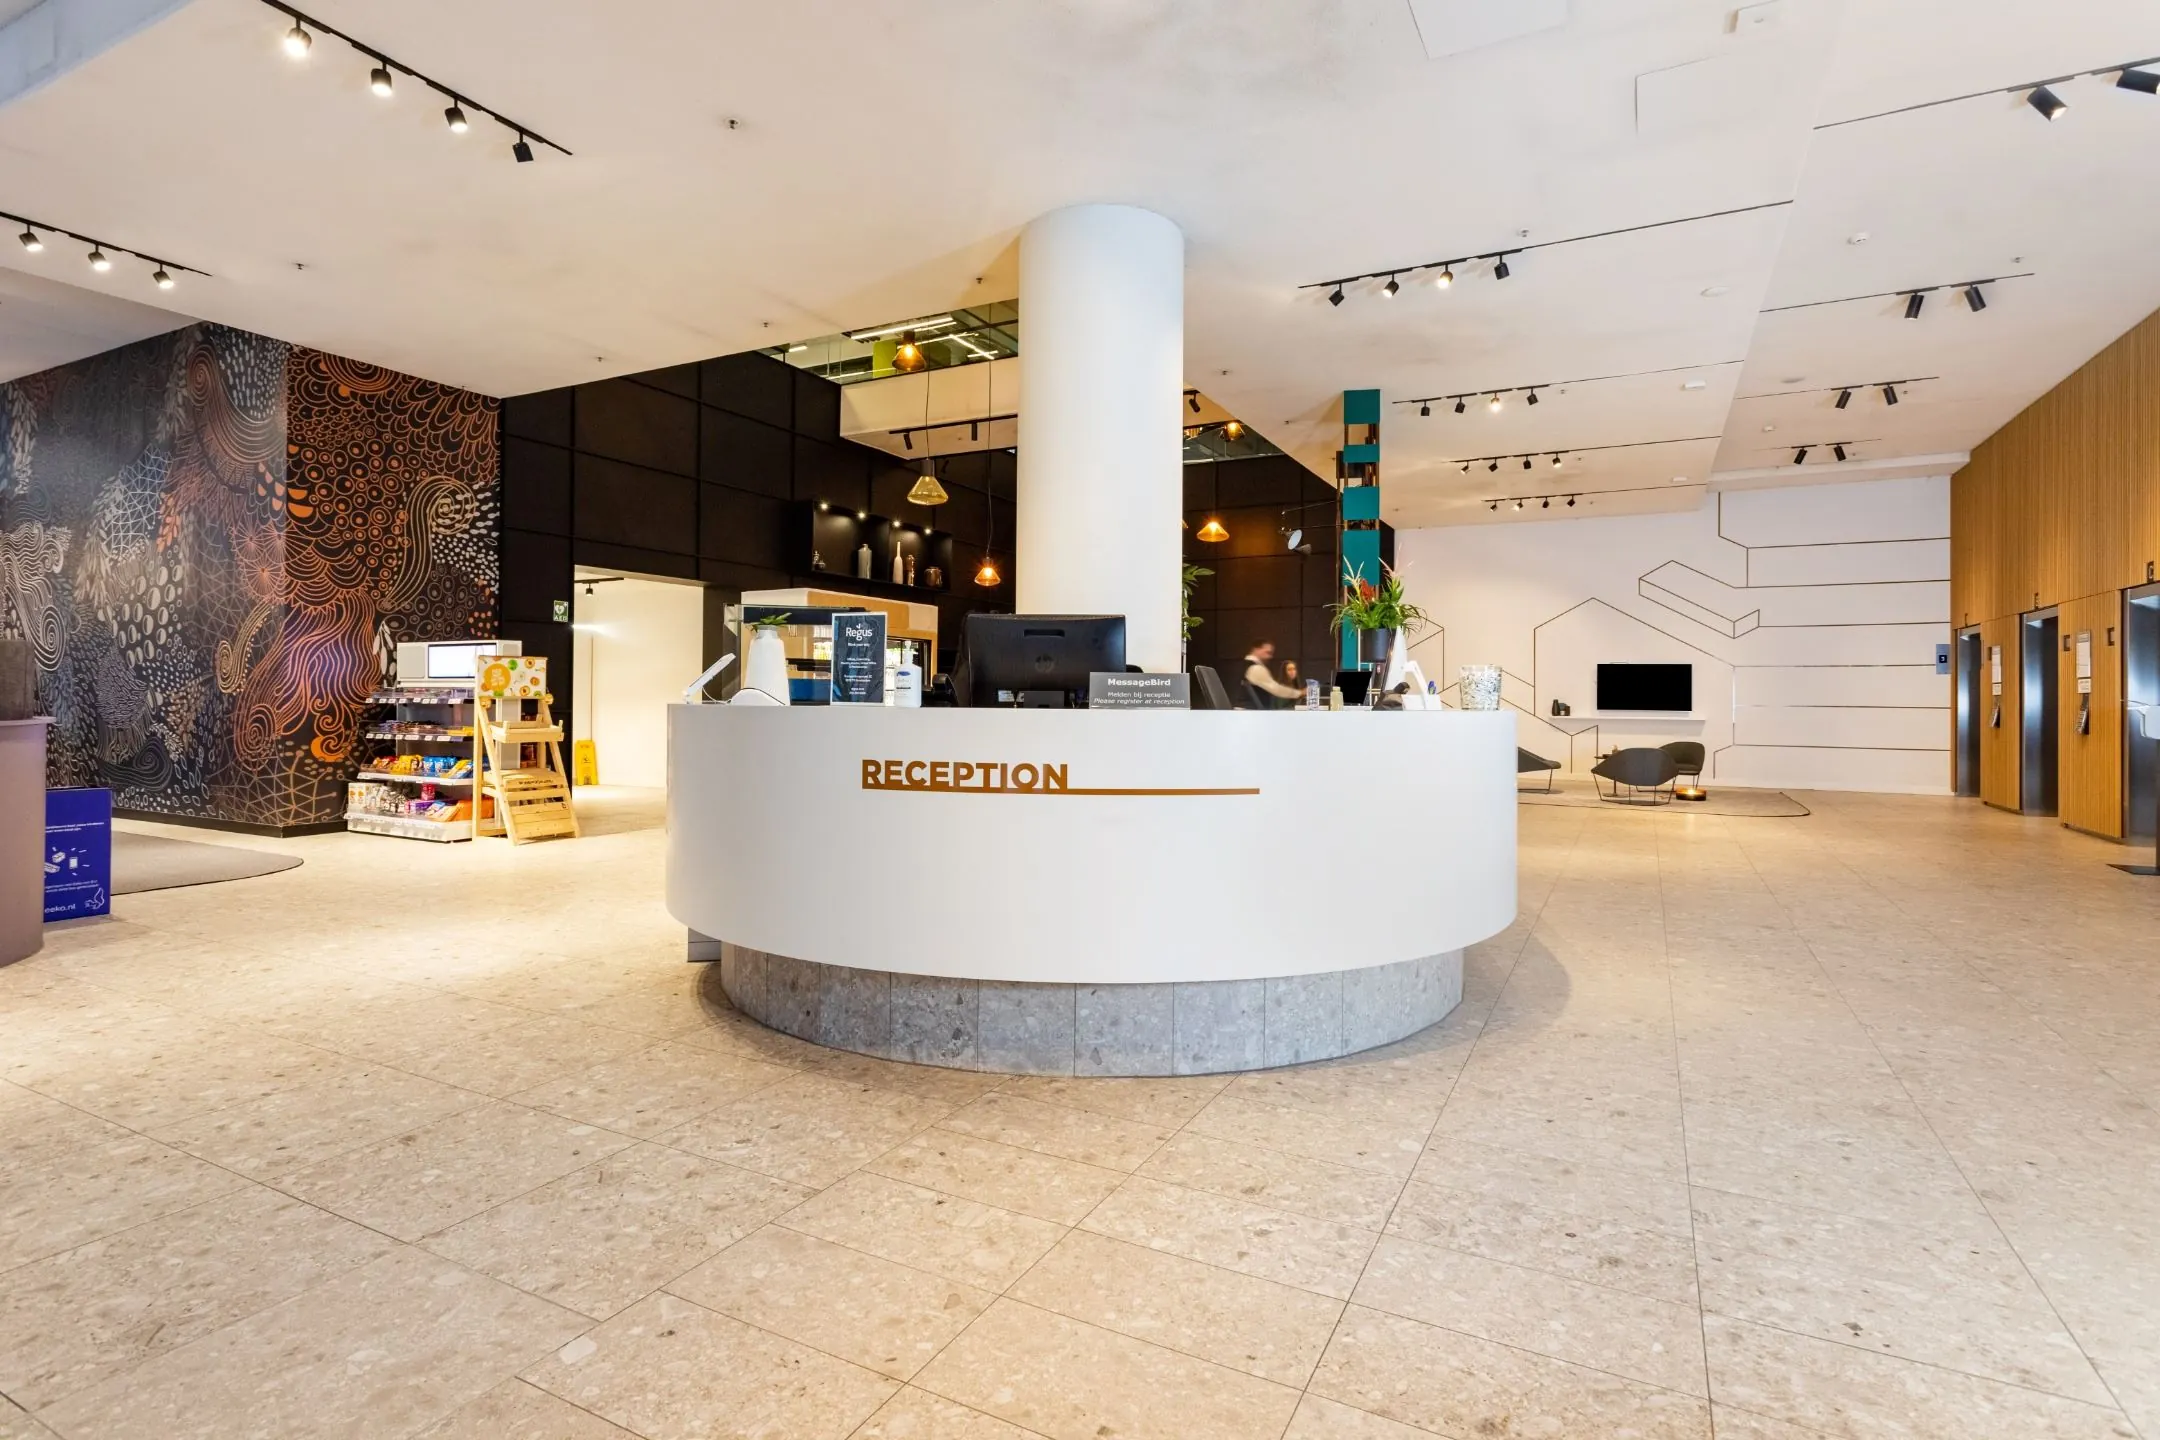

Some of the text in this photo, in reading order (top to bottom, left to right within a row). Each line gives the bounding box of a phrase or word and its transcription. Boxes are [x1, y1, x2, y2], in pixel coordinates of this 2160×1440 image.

[845, 626, 873, 641] Regus
[1107, 678, 1171, 687] MessageBird
[1133, 691, 1142, 699] bij
[862, 759, 1068, 793] RECEPTION
